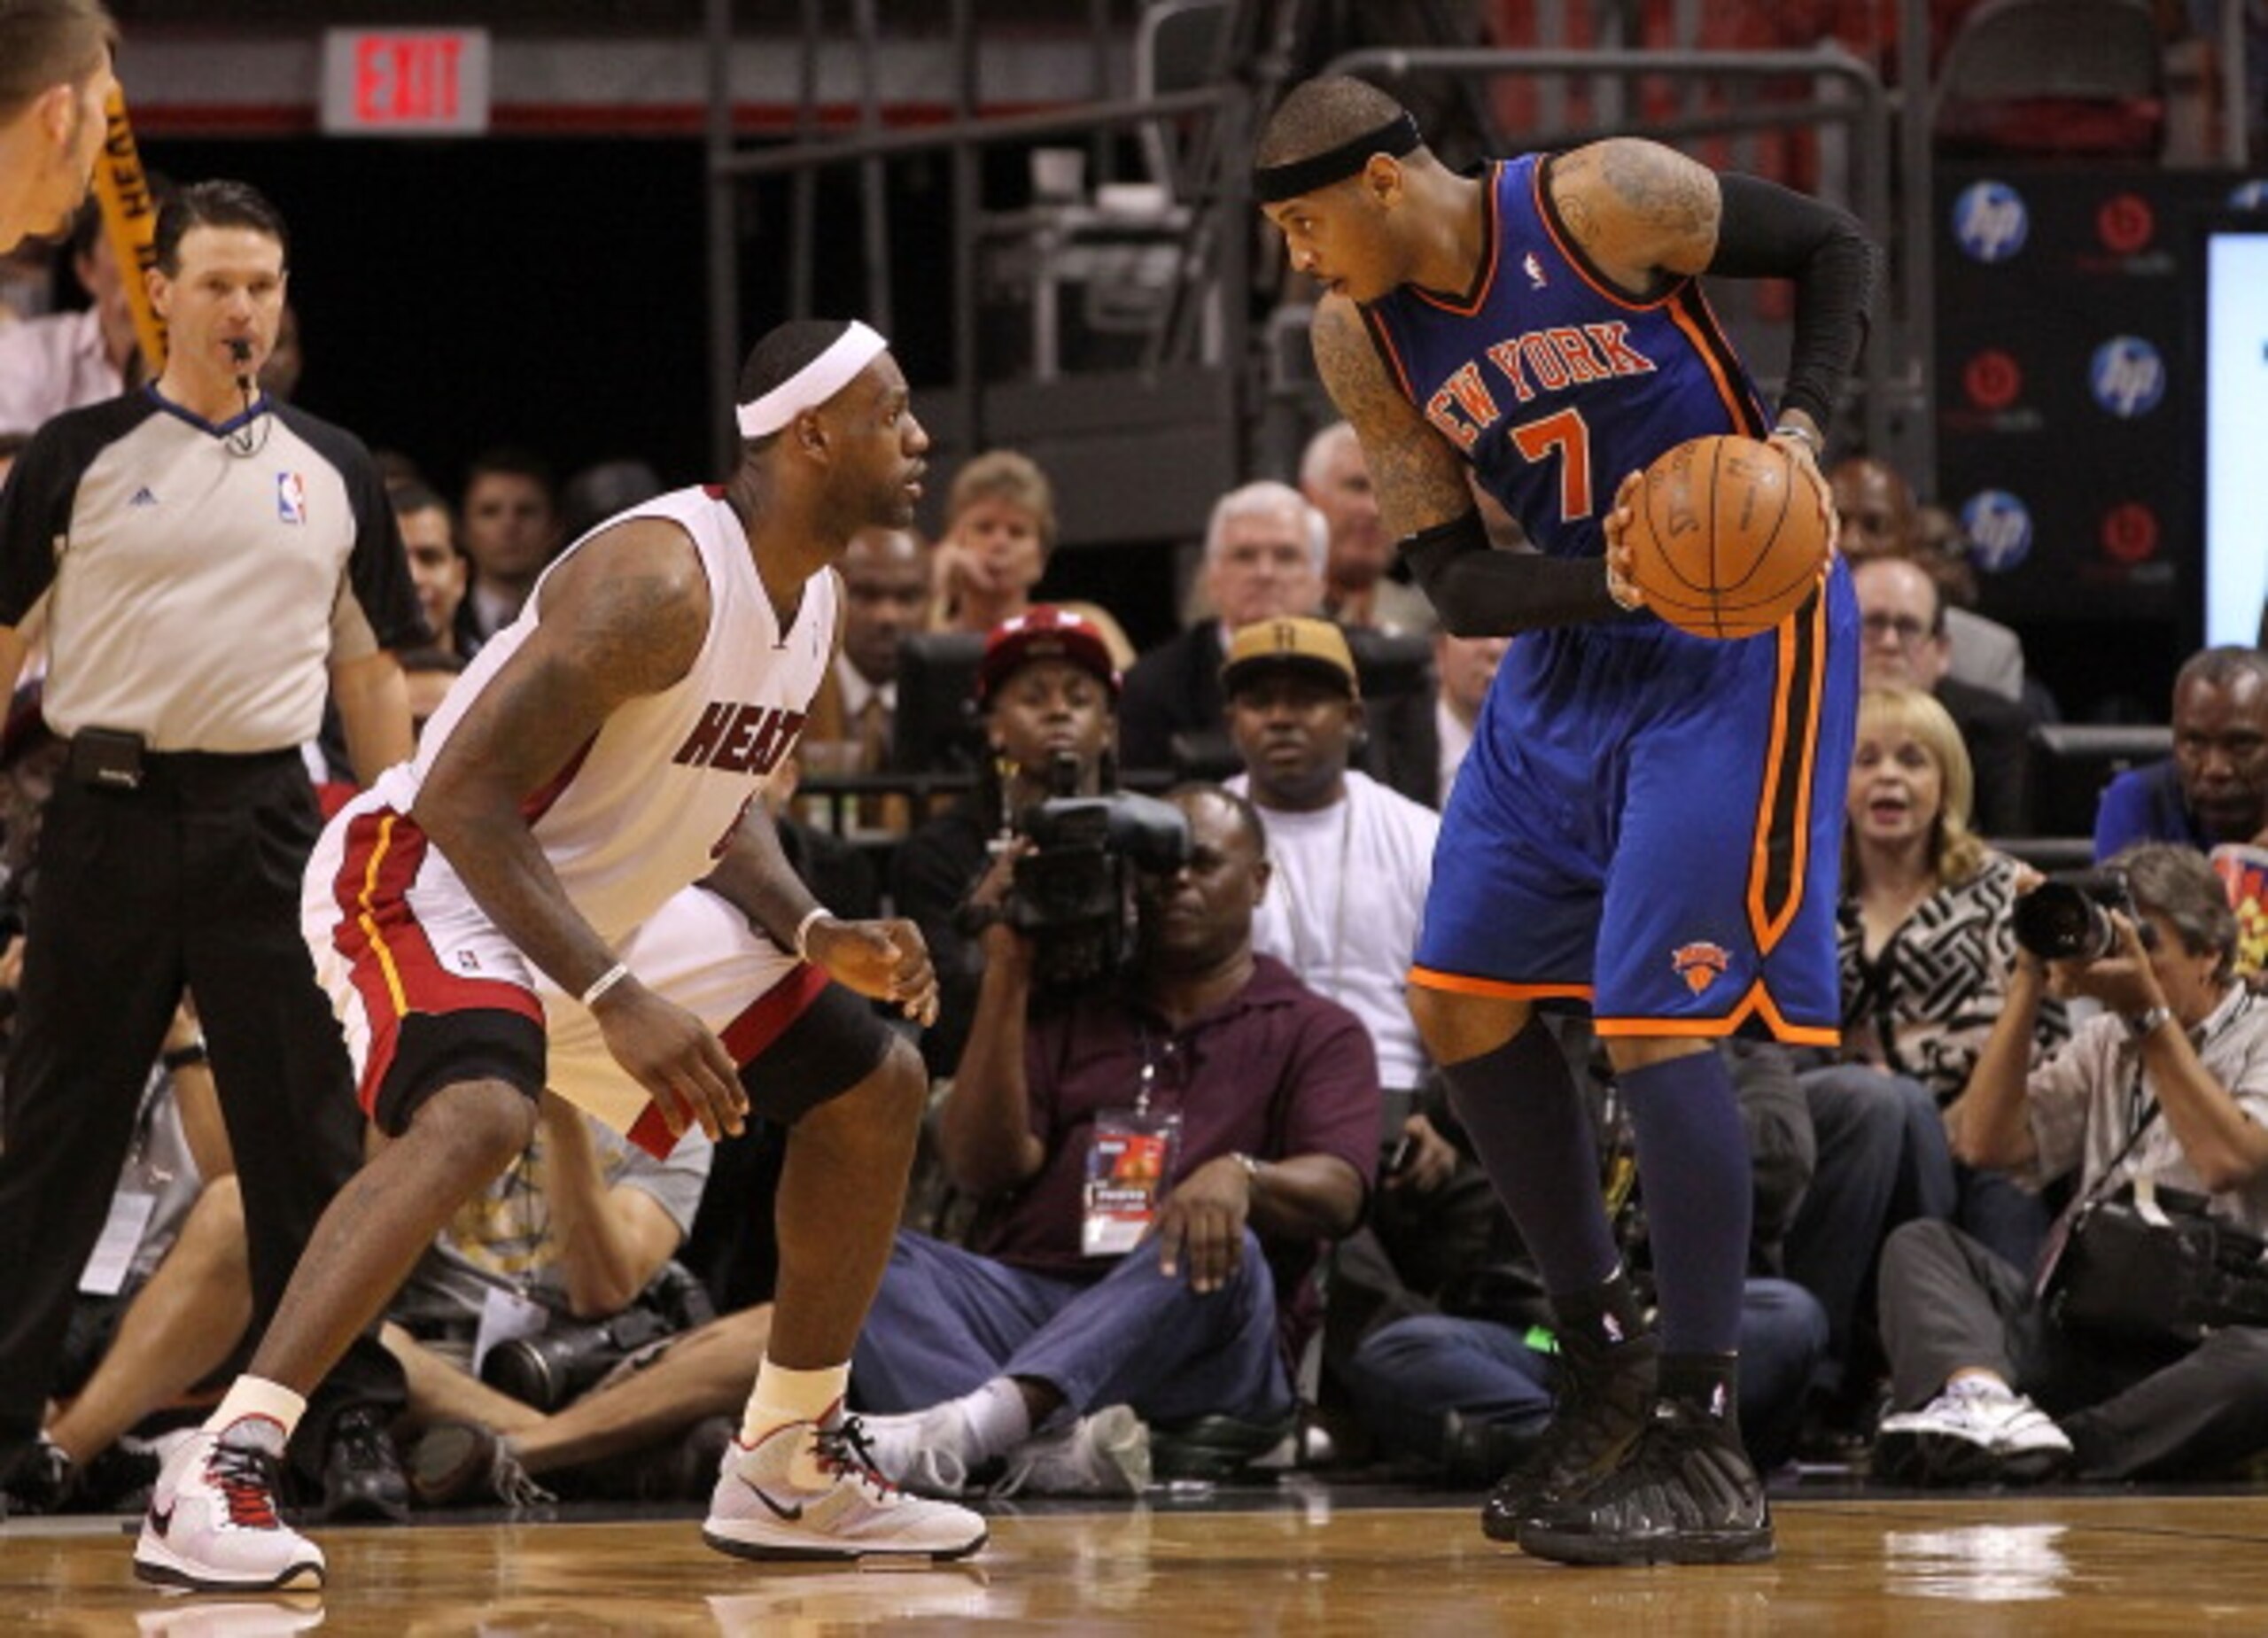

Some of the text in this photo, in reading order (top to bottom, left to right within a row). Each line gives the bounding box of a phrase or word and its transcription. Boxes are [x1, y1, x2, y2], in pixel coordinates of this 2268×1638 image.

[356, 36, 461, 121] EXIT
[1425, 320, 1658, 450] EW YORK
[1509, 407, 1593, 523] 7
[672, 702, 810, 776] HEAT
